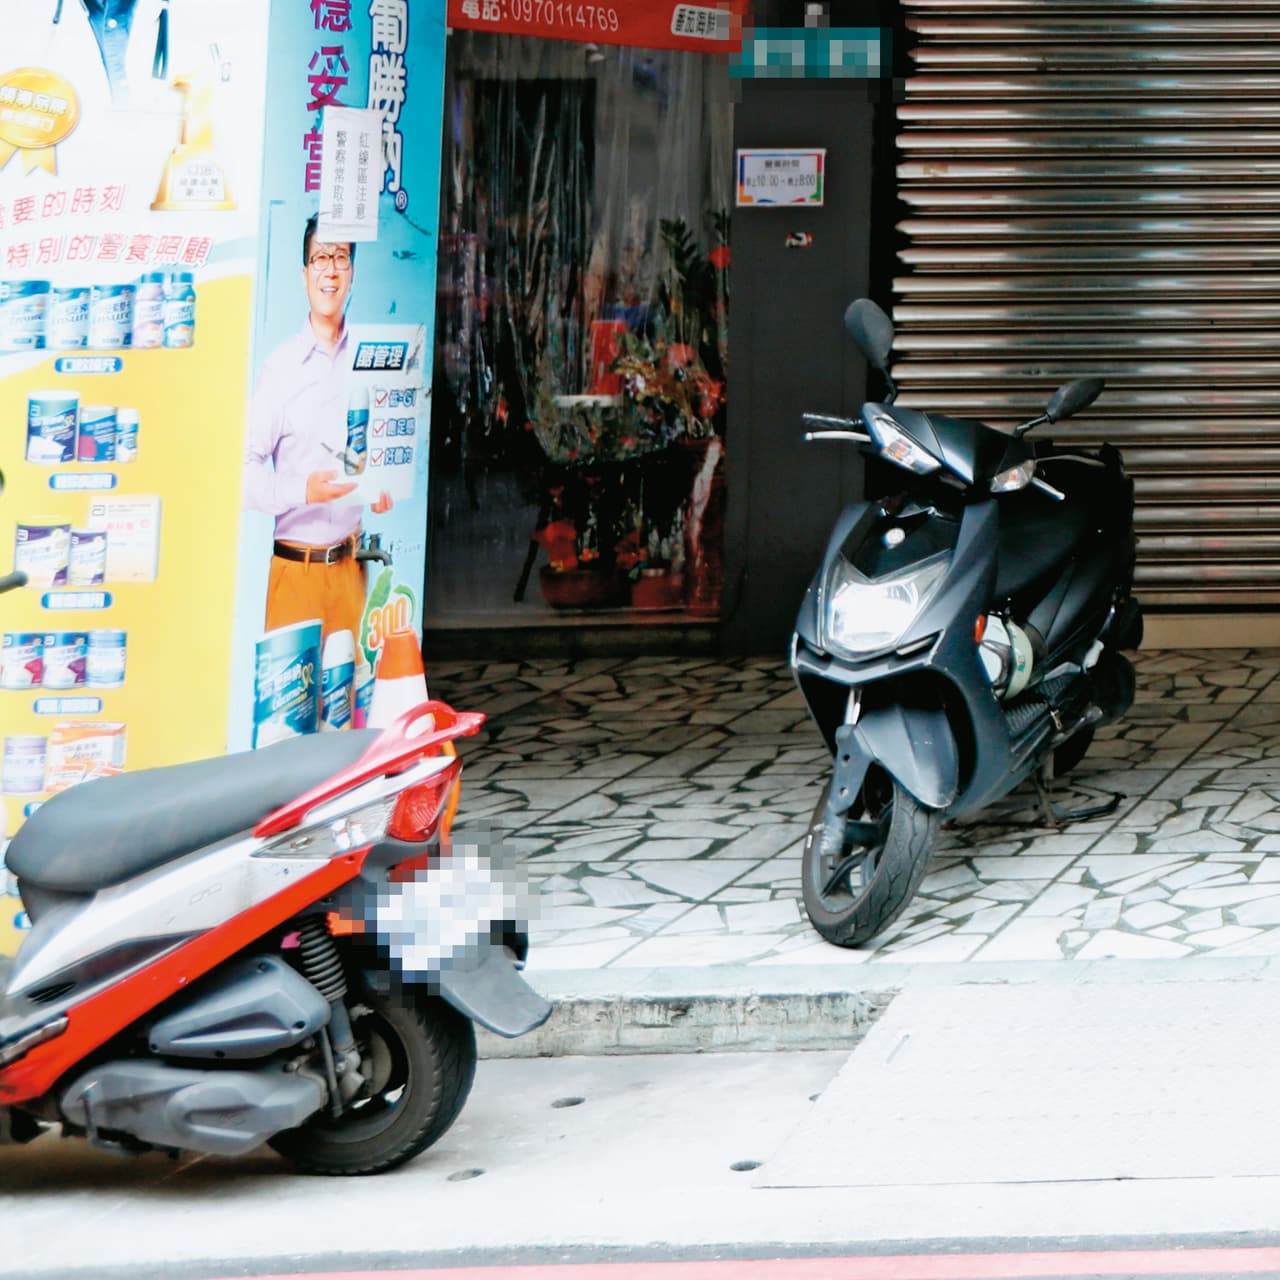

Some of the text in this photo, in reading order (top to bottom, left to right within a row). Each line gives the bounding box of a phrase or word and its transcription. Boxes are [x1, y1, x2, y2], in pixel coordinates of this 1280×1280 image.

[0, 184, 126, 229] 要的時刻
[6, 233, 213, 269] 特別的營養照顧
